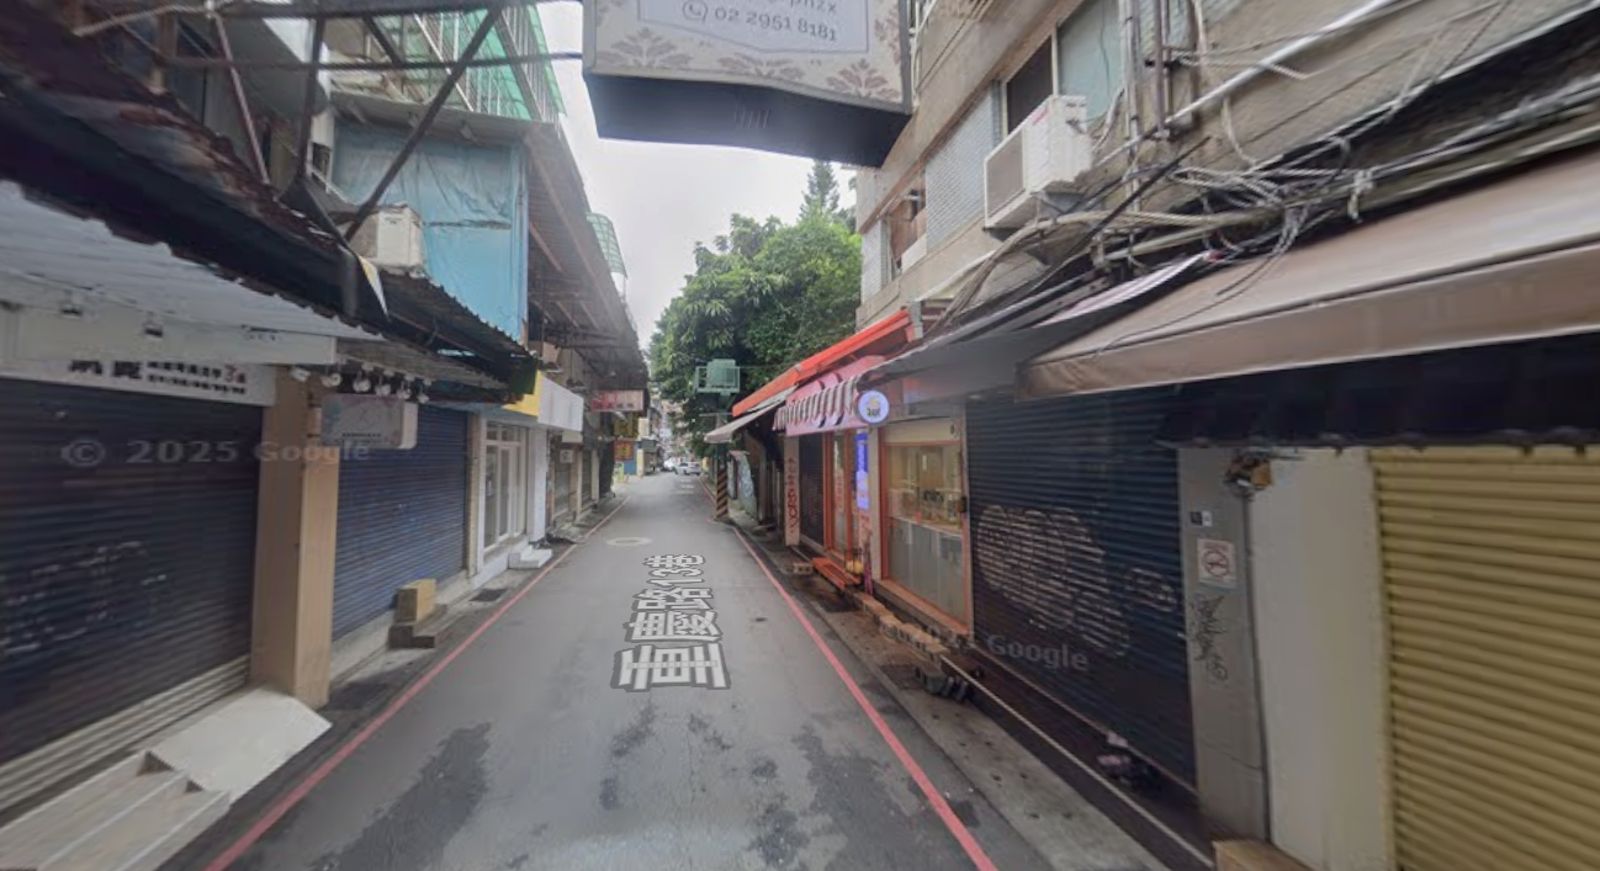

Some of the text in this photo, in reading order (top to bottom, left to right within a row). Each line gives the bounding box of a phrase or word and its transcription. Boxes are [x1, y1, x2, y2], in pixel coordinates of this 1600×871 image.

[714, 7, 837, 41] 02 2951 8181
